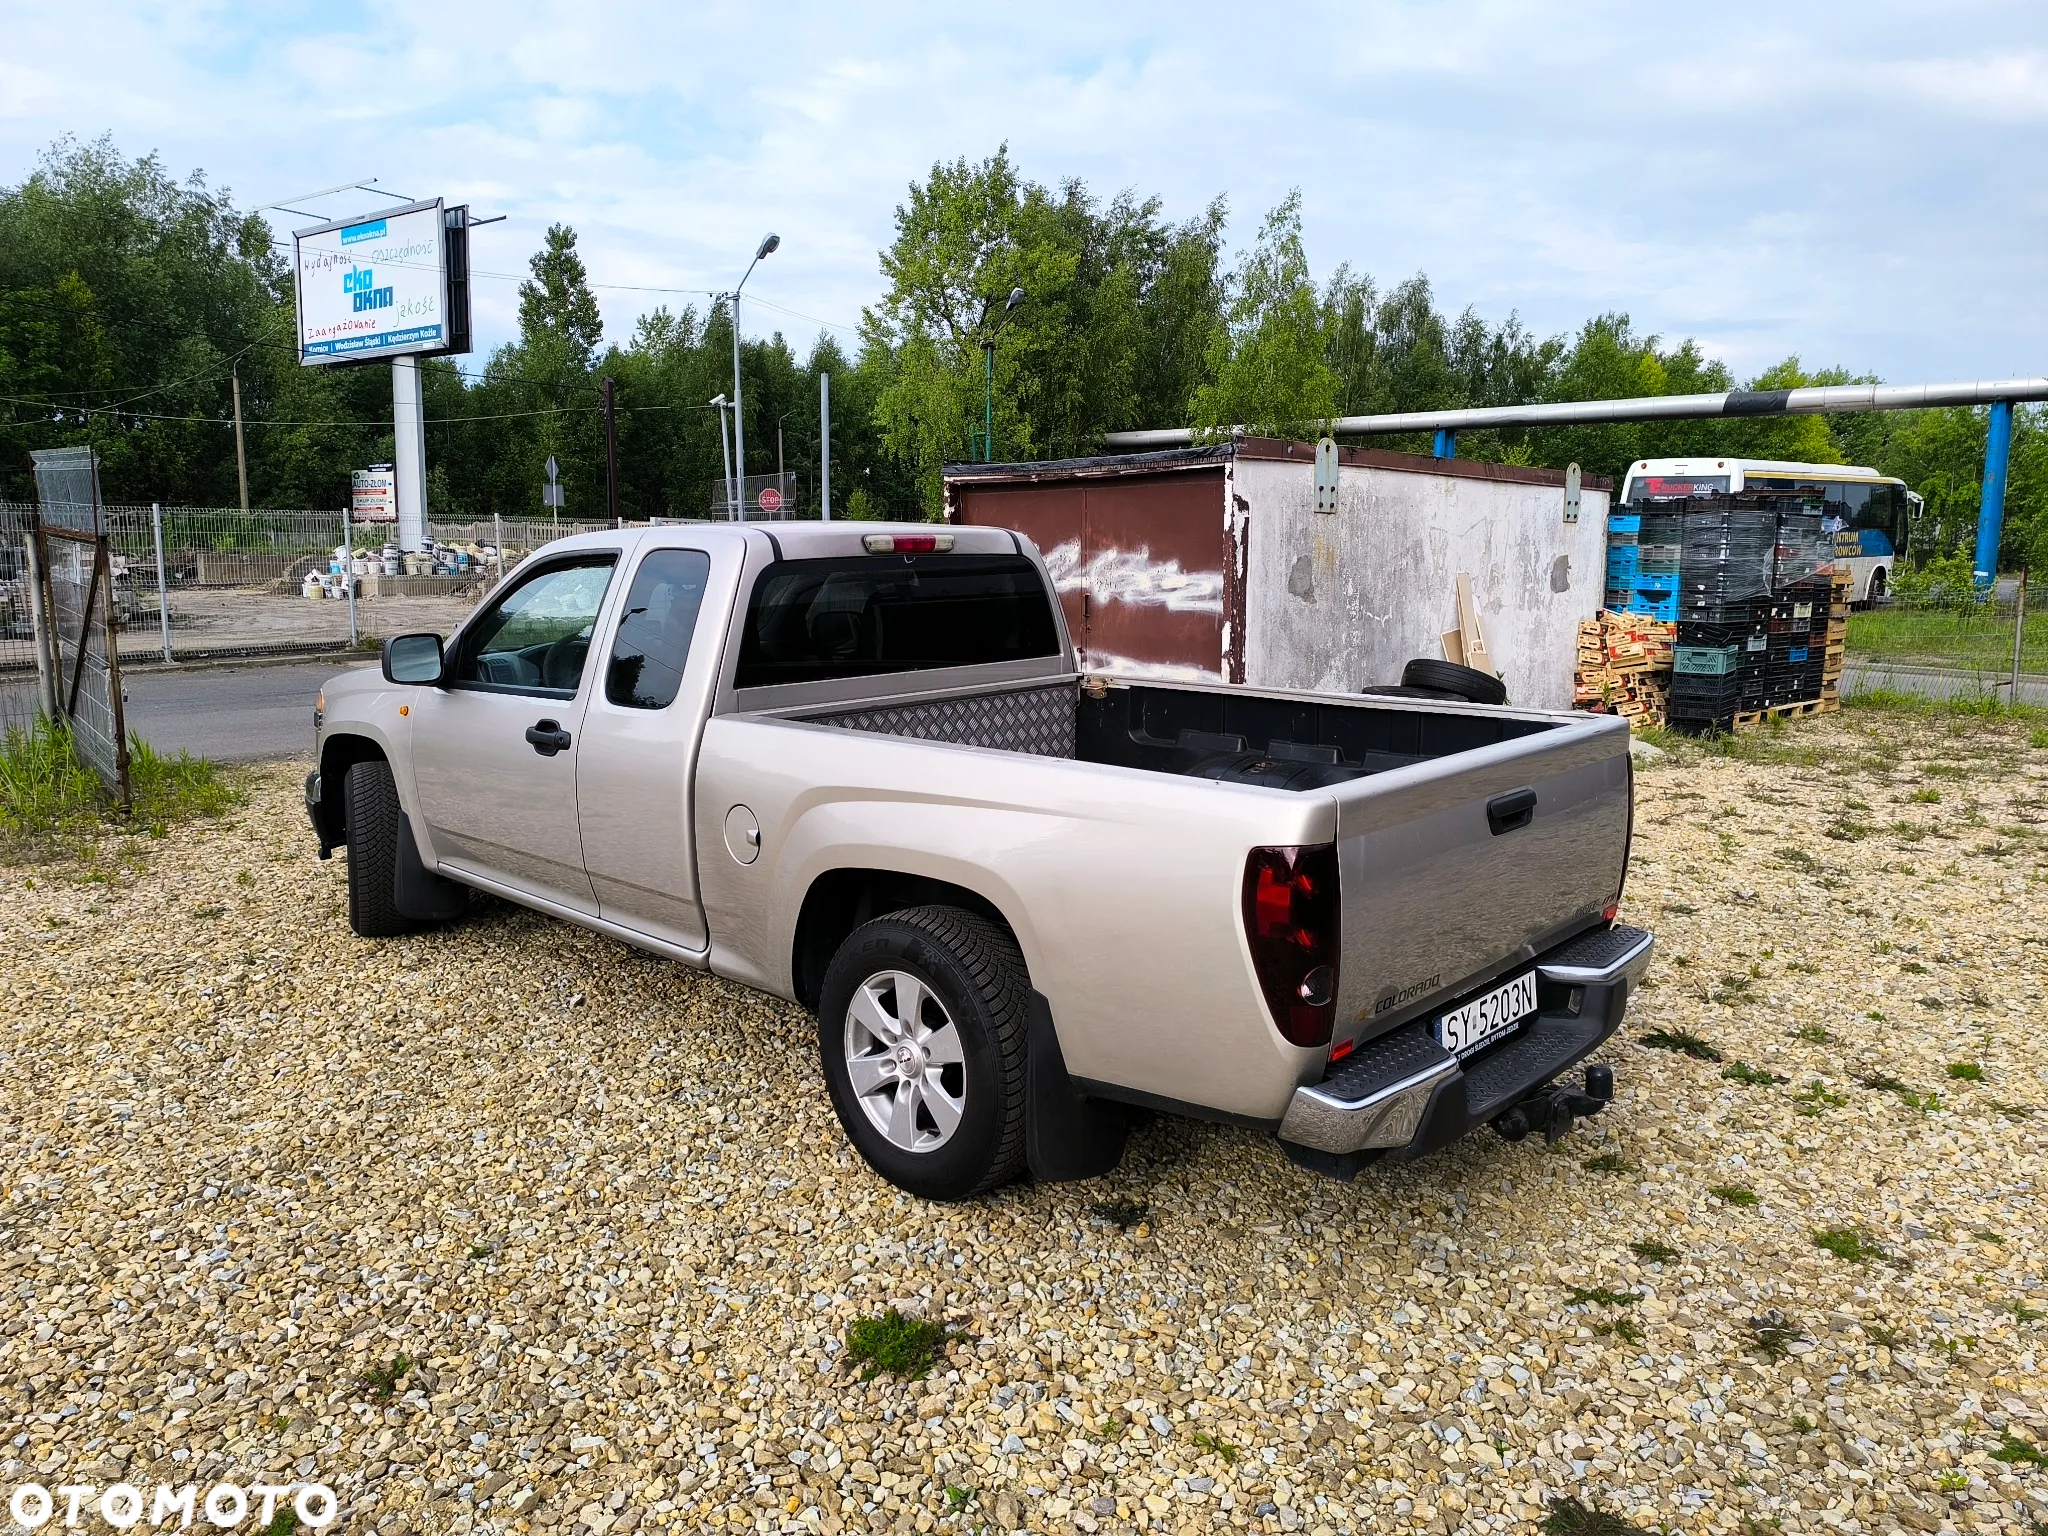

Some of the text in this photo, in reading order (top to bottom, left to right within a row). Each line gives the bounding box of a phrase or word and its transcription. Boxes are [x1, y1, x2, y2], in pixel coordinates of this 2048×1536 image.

[342, 227, 386, 244] www.ekookna.pl
[335, 339, 364, 351] Wodzisław
[364, 336, 381, 347] Śląski
[420, 327, 437, 338] Koźle
[353, 479, 387, 488] AUTO-ZŁOM
[761, 496, 780, 504] STOP
[1375, 973, 1440, 1015] COLORADO
[1447, 975, 1533, 1052] SY 5203N
[1461, 1046, 1475, 1060] DROGI
[1490, 1029, 1506, 1043] BYTOM
[1506, 1021, 1519, 1035] JEDZIE
